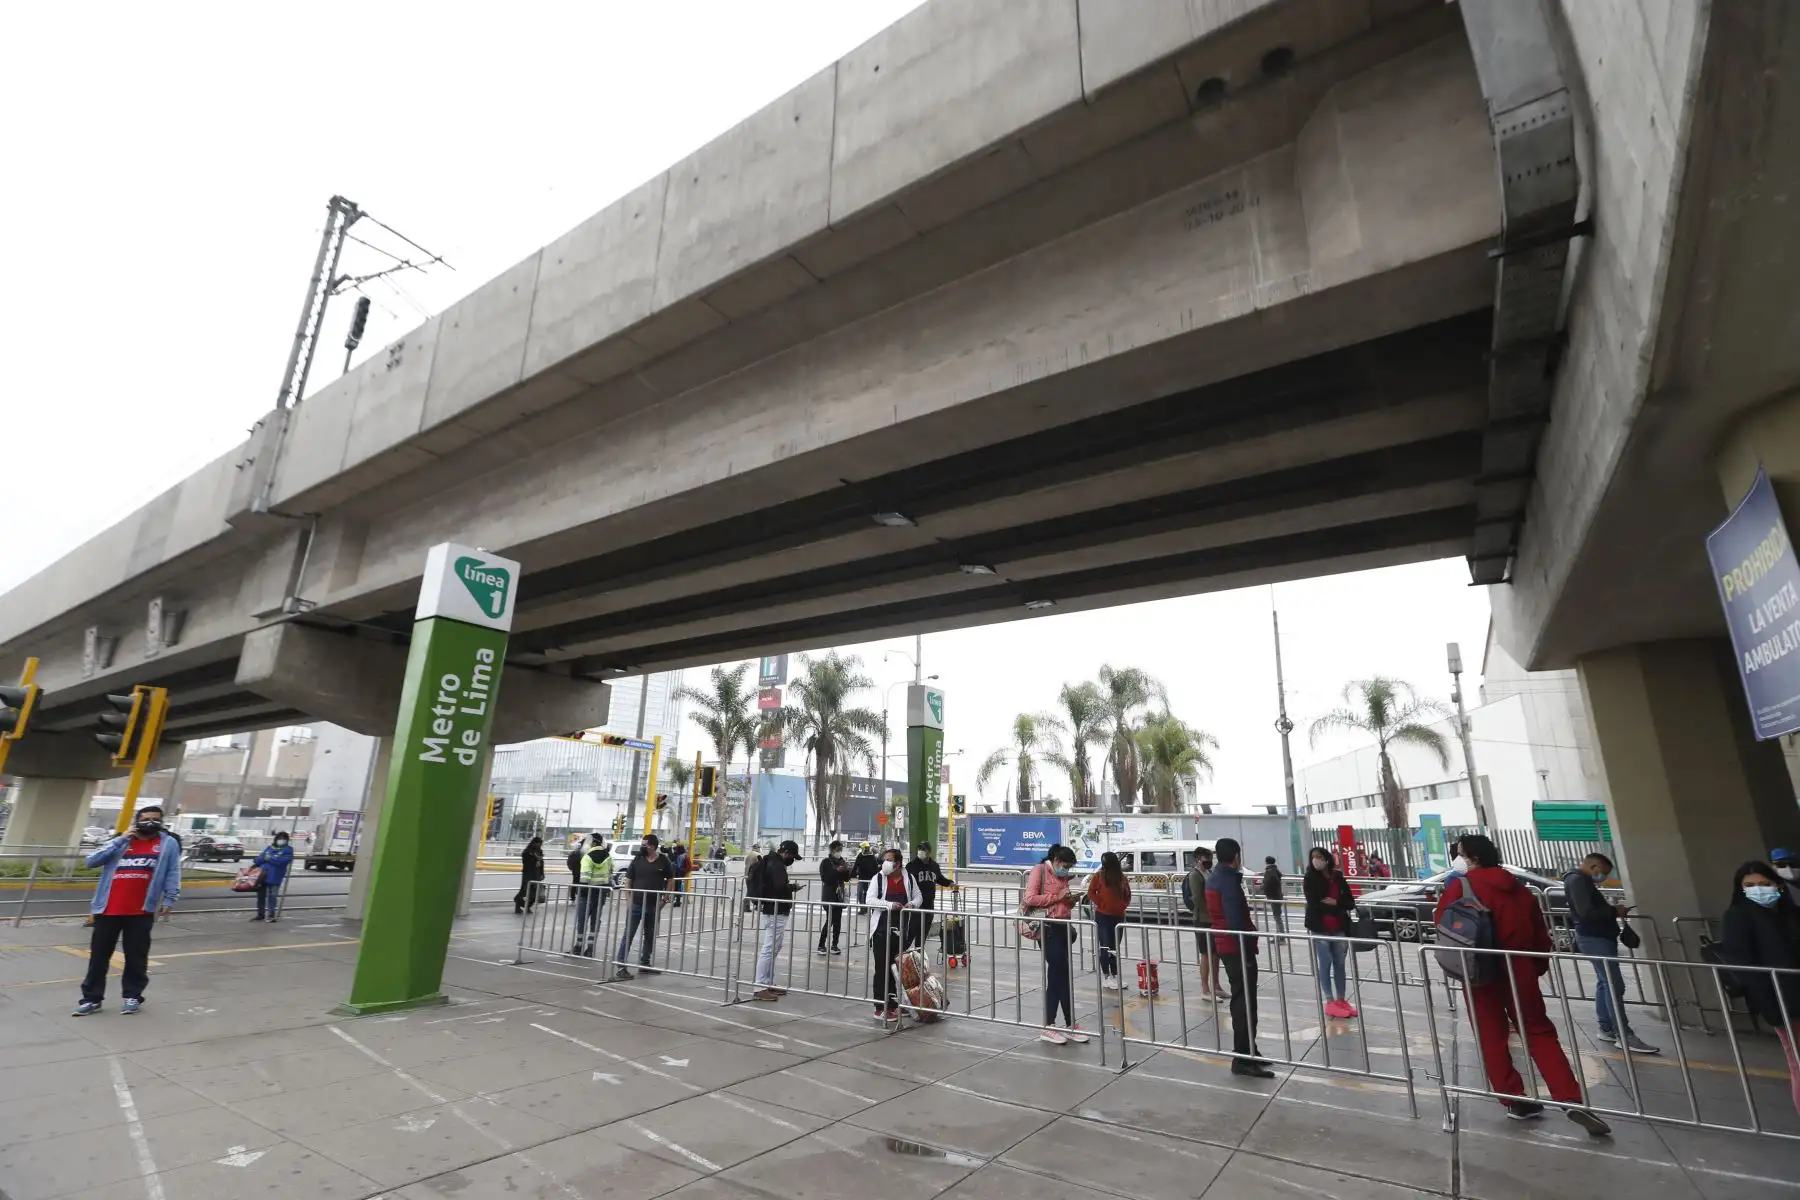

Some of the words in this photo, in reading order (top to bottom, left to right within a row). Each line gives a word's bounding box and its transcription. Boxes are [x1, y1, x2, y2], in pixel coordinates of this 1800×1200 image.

[490, 590, 503, 614] 1
[1749, 606, 1765, 634] LA
[1764, 580, 1799, 619] VENTA
[1744, 619, 1800, 674] AMBULATO
[460, 648, 495, 716] Lima
[419, 673, 460, 763] Metro
[938, 707, 942, 721] 1
[453, 729, 481, 766] de
[934, 740, 942, 777] Lima
[925, 756, 934, 803] Metro
[933, 784, 940, 804] de
[1022, 831, 1045, 839] BBVA
[1347, 851, 1357, 875] Claro
